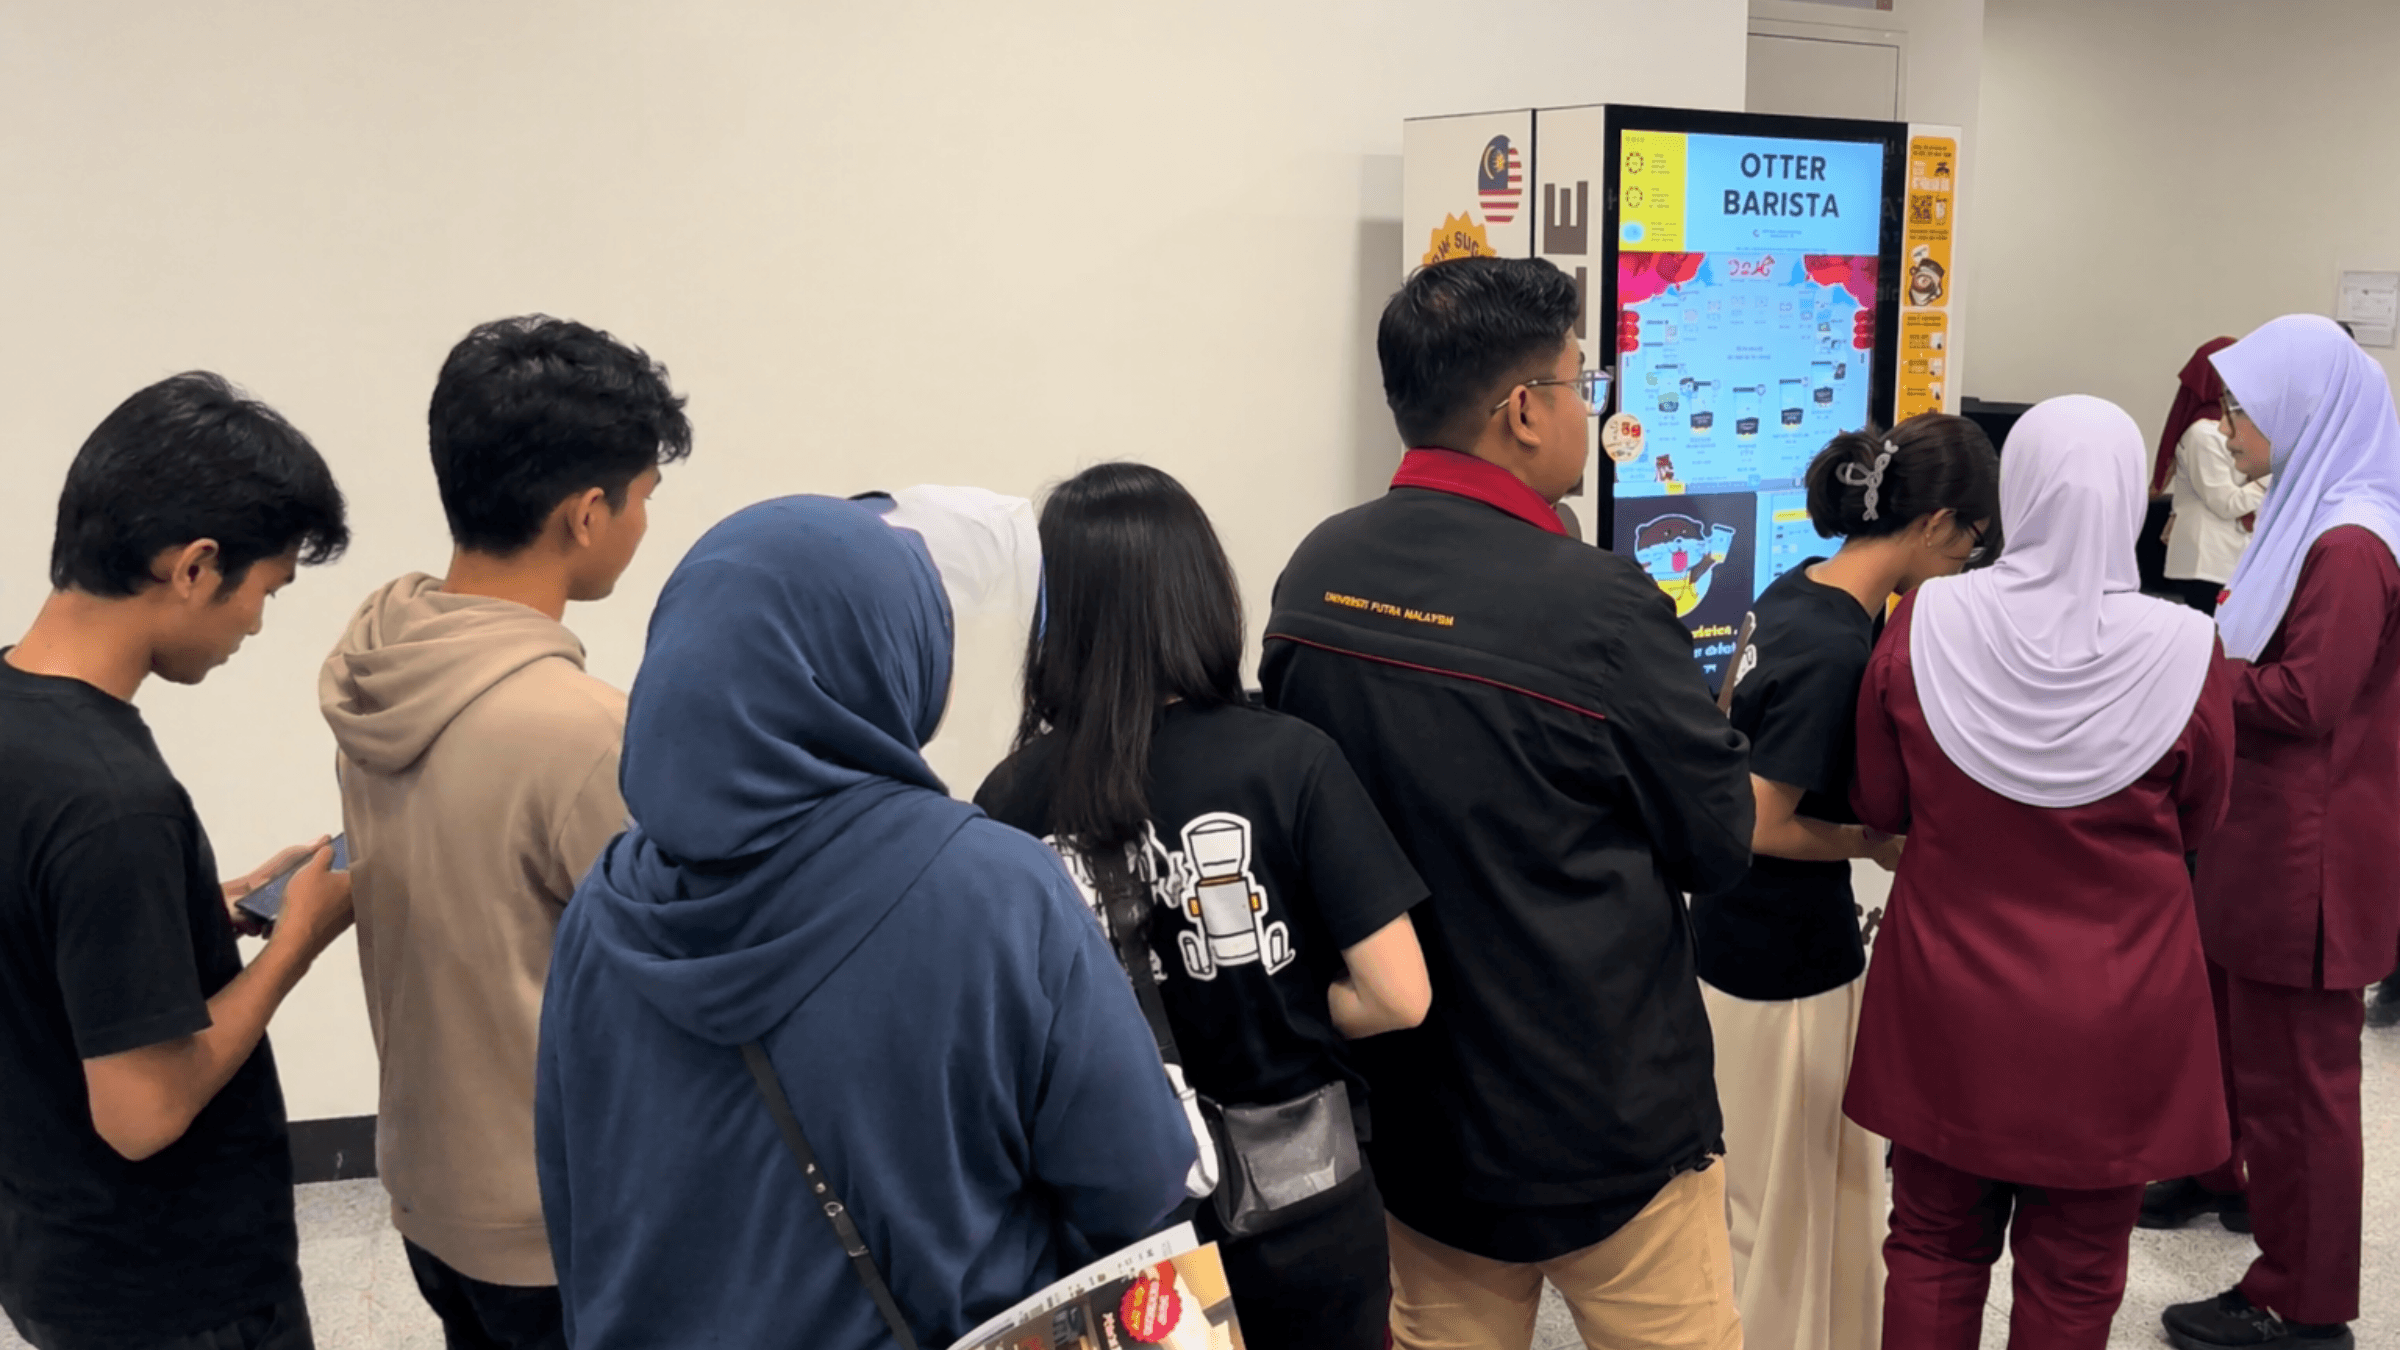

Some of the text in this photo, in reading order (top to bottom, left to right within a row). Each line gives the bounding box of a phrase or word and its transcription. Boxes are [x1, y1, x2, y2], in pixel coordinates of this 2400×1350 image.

[1740, 152, 1826, 181] OTTER
[1723, 189, 1839, 218] BARISTA
[1371, 601, 1401, 616] PUTRA
